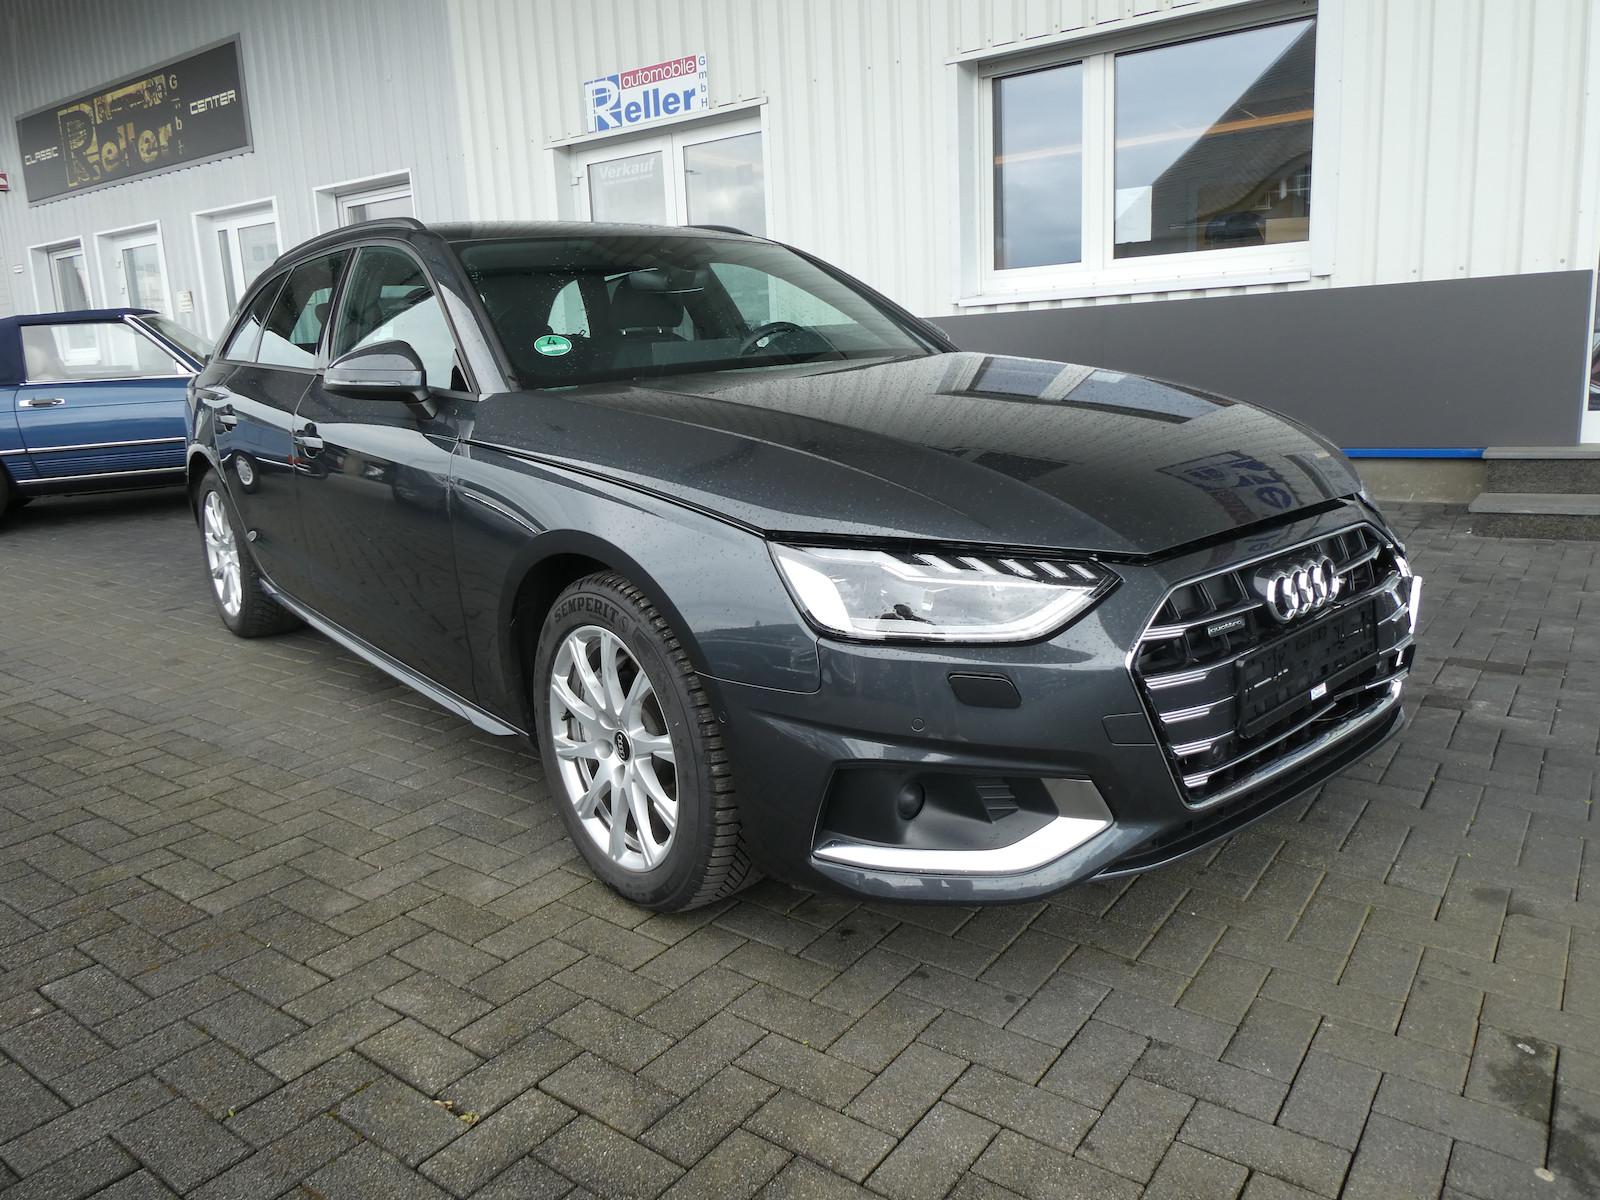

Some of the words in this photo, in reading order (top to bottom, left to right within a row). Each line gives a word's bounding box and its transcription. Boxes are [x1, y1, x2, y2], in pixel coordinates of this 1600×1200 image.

[622, 59, 696, 89] automobile
[190, 89, 236, 115] CENTER
[584, 76, 696, 133] Reller
[600, 157, 656, 179] Verkauf
[547, 337, 557, 345] 4
[554, 597, 619, 624] SEMPERIT
